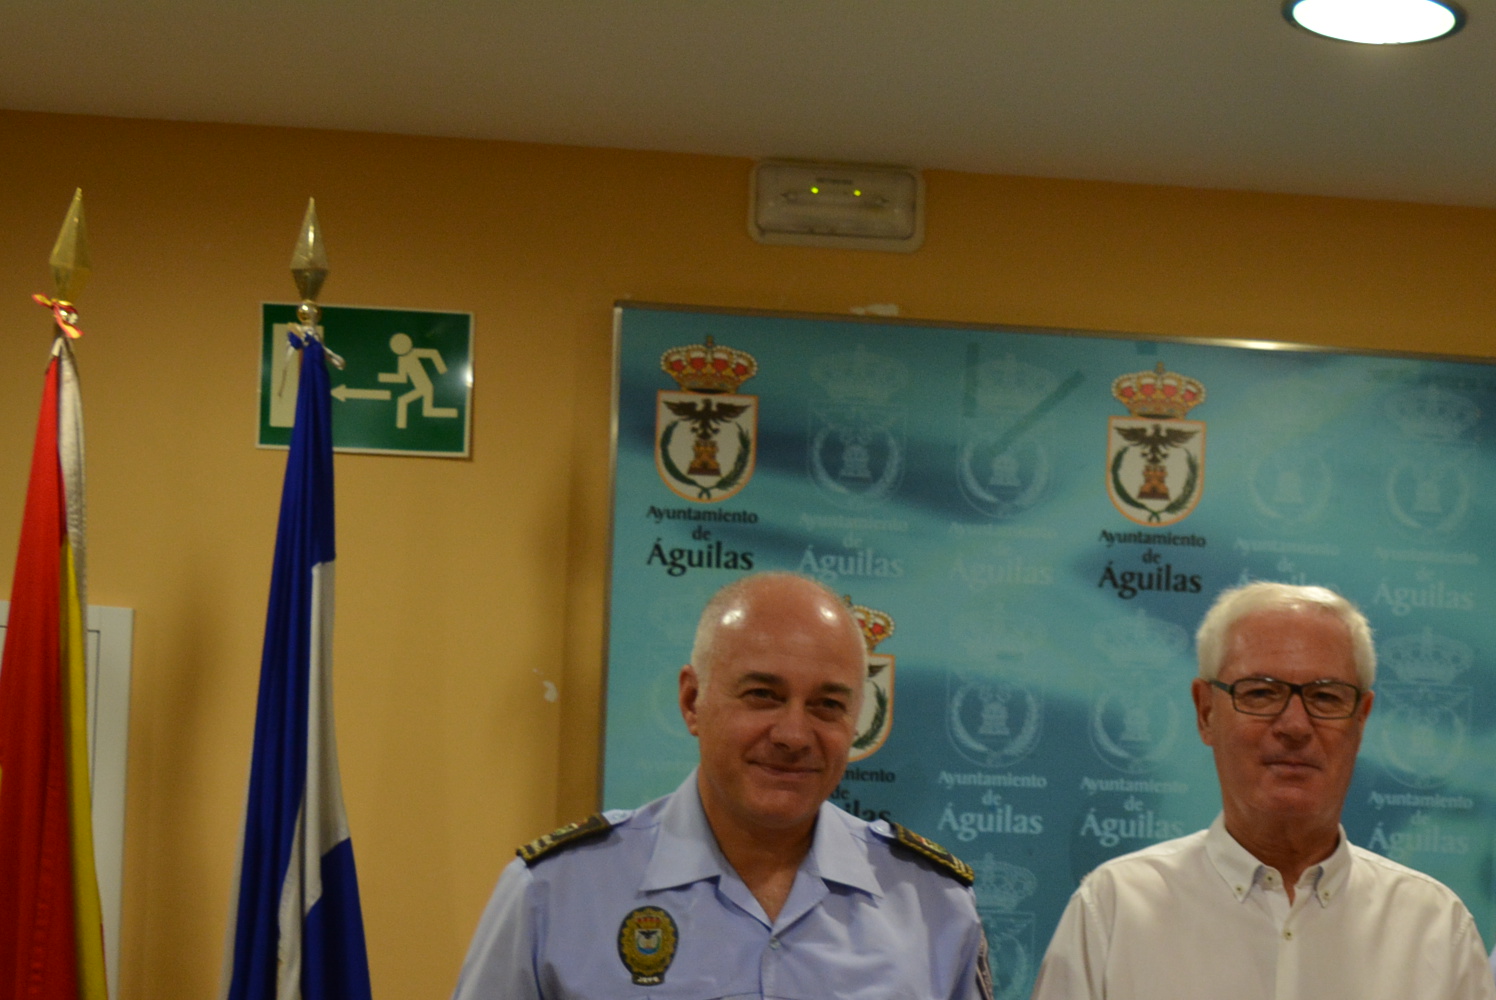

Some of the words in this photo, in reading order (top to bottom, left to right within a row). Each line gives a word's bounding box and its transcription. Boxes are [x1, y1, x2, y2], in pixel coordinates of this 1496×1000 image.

[646, 506, 758, 524] Ayuntamiento
[692, 525, 712, 542] de
[843, 532, 862, 548] de
[1098, 529, 1208, 548] Ayuntamiento
[646, 537, 754, 577] Águilas
[800, 545, 901, 583] Águilas
[1143, 549, 1162, 564] de
[950, 556, 1053, 592] Águilas
[1098, 560, 1202, 600] Águilas
[1373, 576, 1475, 616] Águilas
[846, 767, 896, 783] miento
[939, 770, 1048, 789] Ayuntamiento
[1079, 776, 1189, 796] Ayuntamiento
[981, 789, 1002, 806] de
[1123, 795, 1144, 811] de
[1368, 790, 1473, 810] Ayuntamiento
[937, 801, 1043, 842] Águilas
[1079, 807, 1184, 847] Águilas
[1410, 810, 1430, 825] de
[1369, 820, 1471, 858] Águilas
